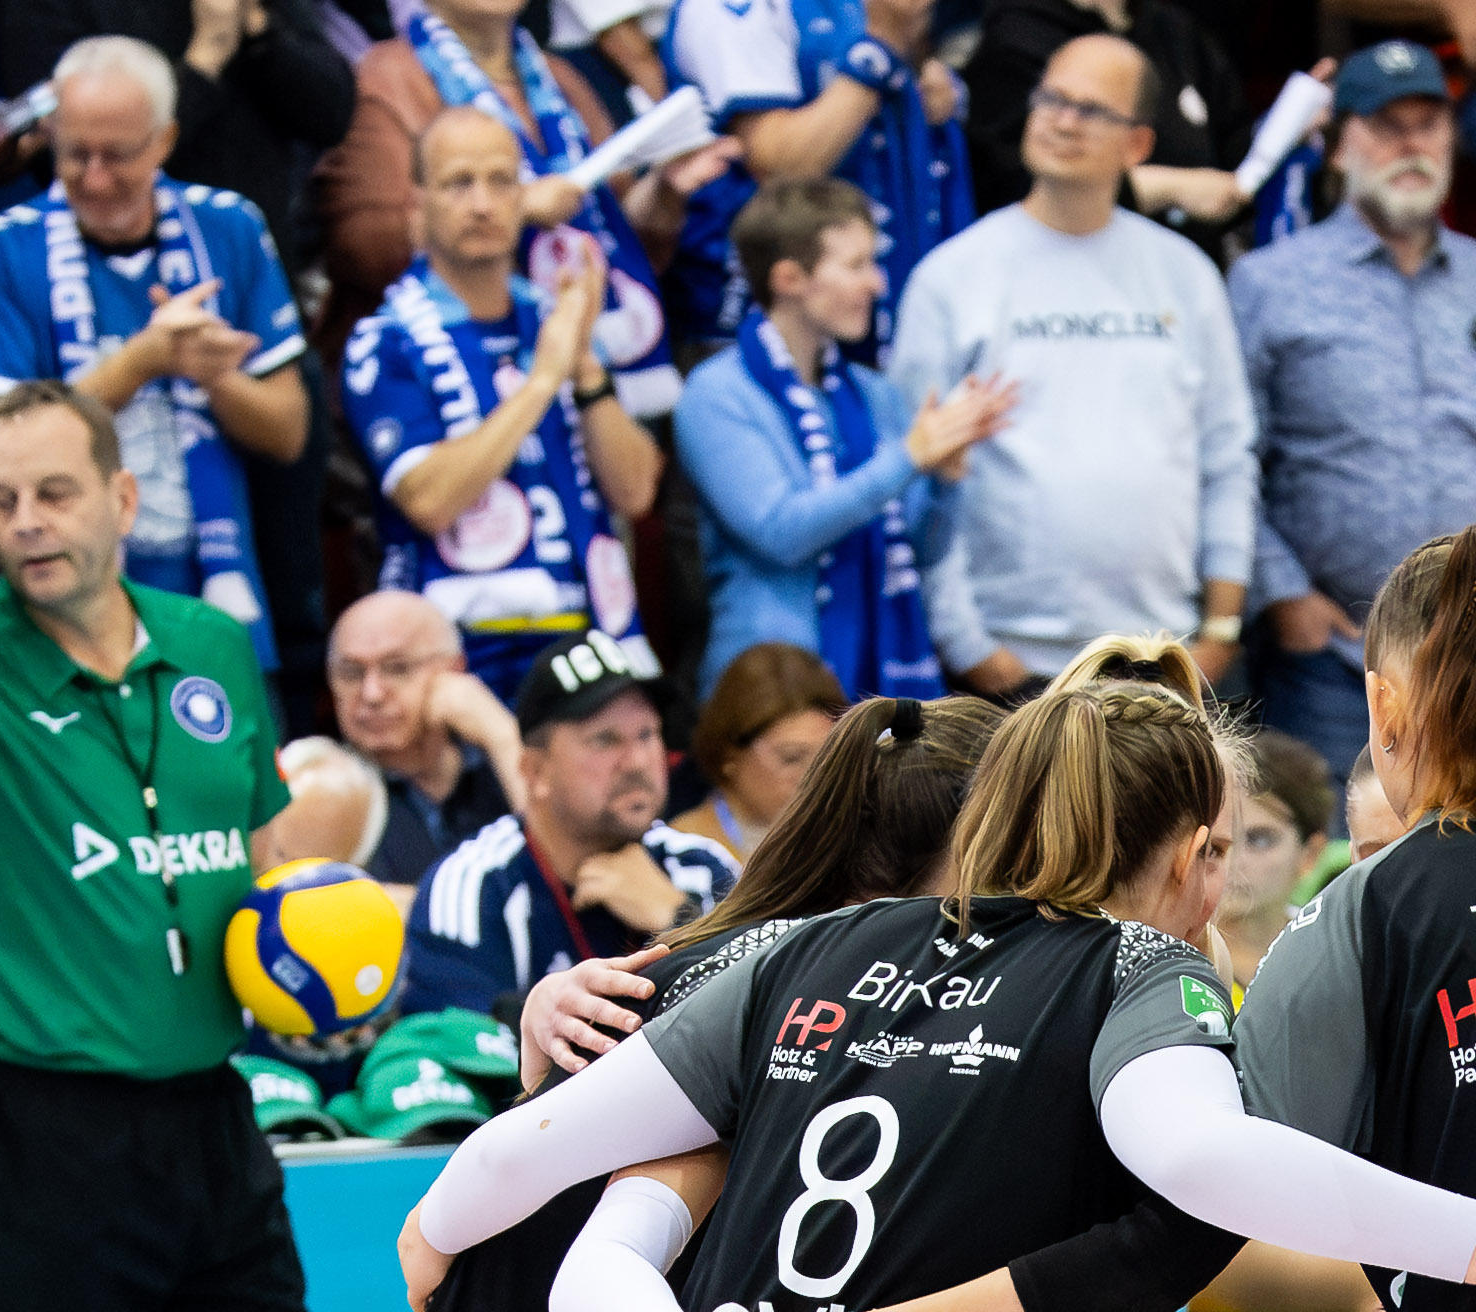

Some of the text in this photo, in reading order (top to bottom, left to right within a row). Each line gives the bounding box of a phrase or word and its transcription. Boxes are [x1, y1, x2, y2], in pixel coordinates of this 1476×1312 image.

[127, 827, 248, 876] DEKRA
[770, 1045, 817, 1067] Hotz &
[845, 1038, 926, 1057] KAPP
[928, 1039, 1021, 1063] HOFMANN
[766, 1063, 819, 1084] Partner
[777, 1095, 900, 1299] 8
